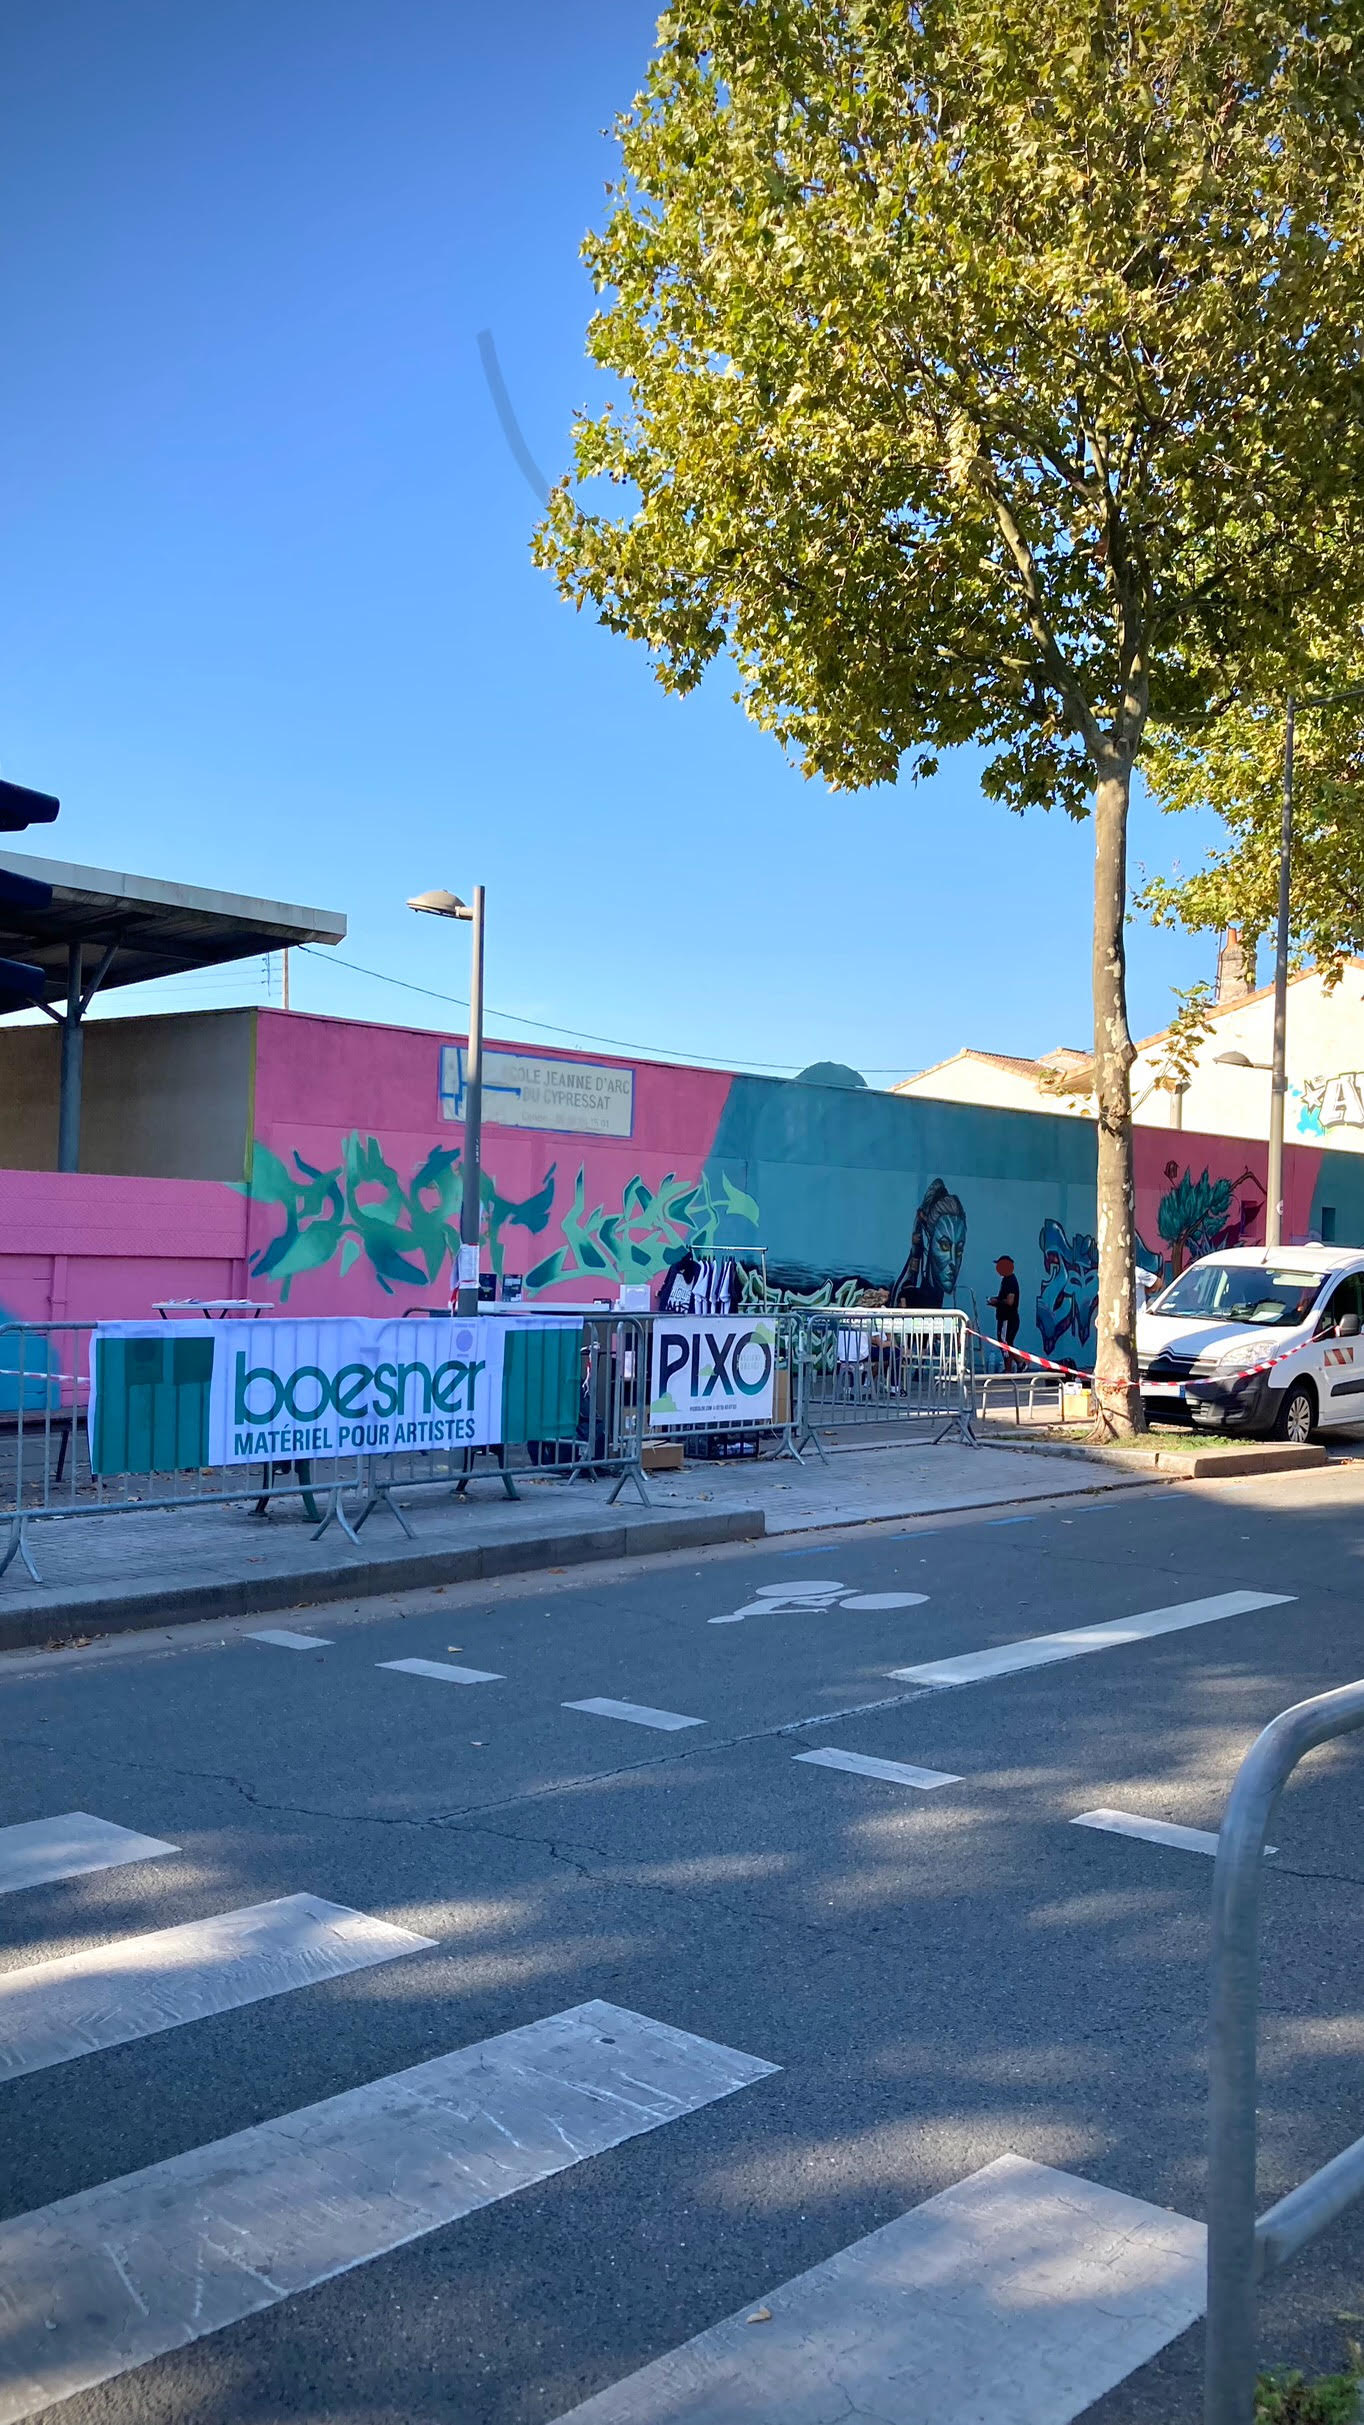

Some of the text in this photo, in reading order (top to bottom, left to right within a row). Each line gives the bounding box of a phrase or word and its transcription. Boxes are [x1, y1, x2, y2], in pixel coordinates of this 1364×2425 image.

[523, 1087, 611, 1110] DU CYPRESSAT
[543, 1070, 593, 1091] JEANNE
[595, 1077, 630, 1095] D'ARC
[659, 1332, 772, 1399] PIXO
[234, 1351, 486, 1425] boesner
[234, 1418, 476, 1456] MATÉRIEL POUR ARTISTES
